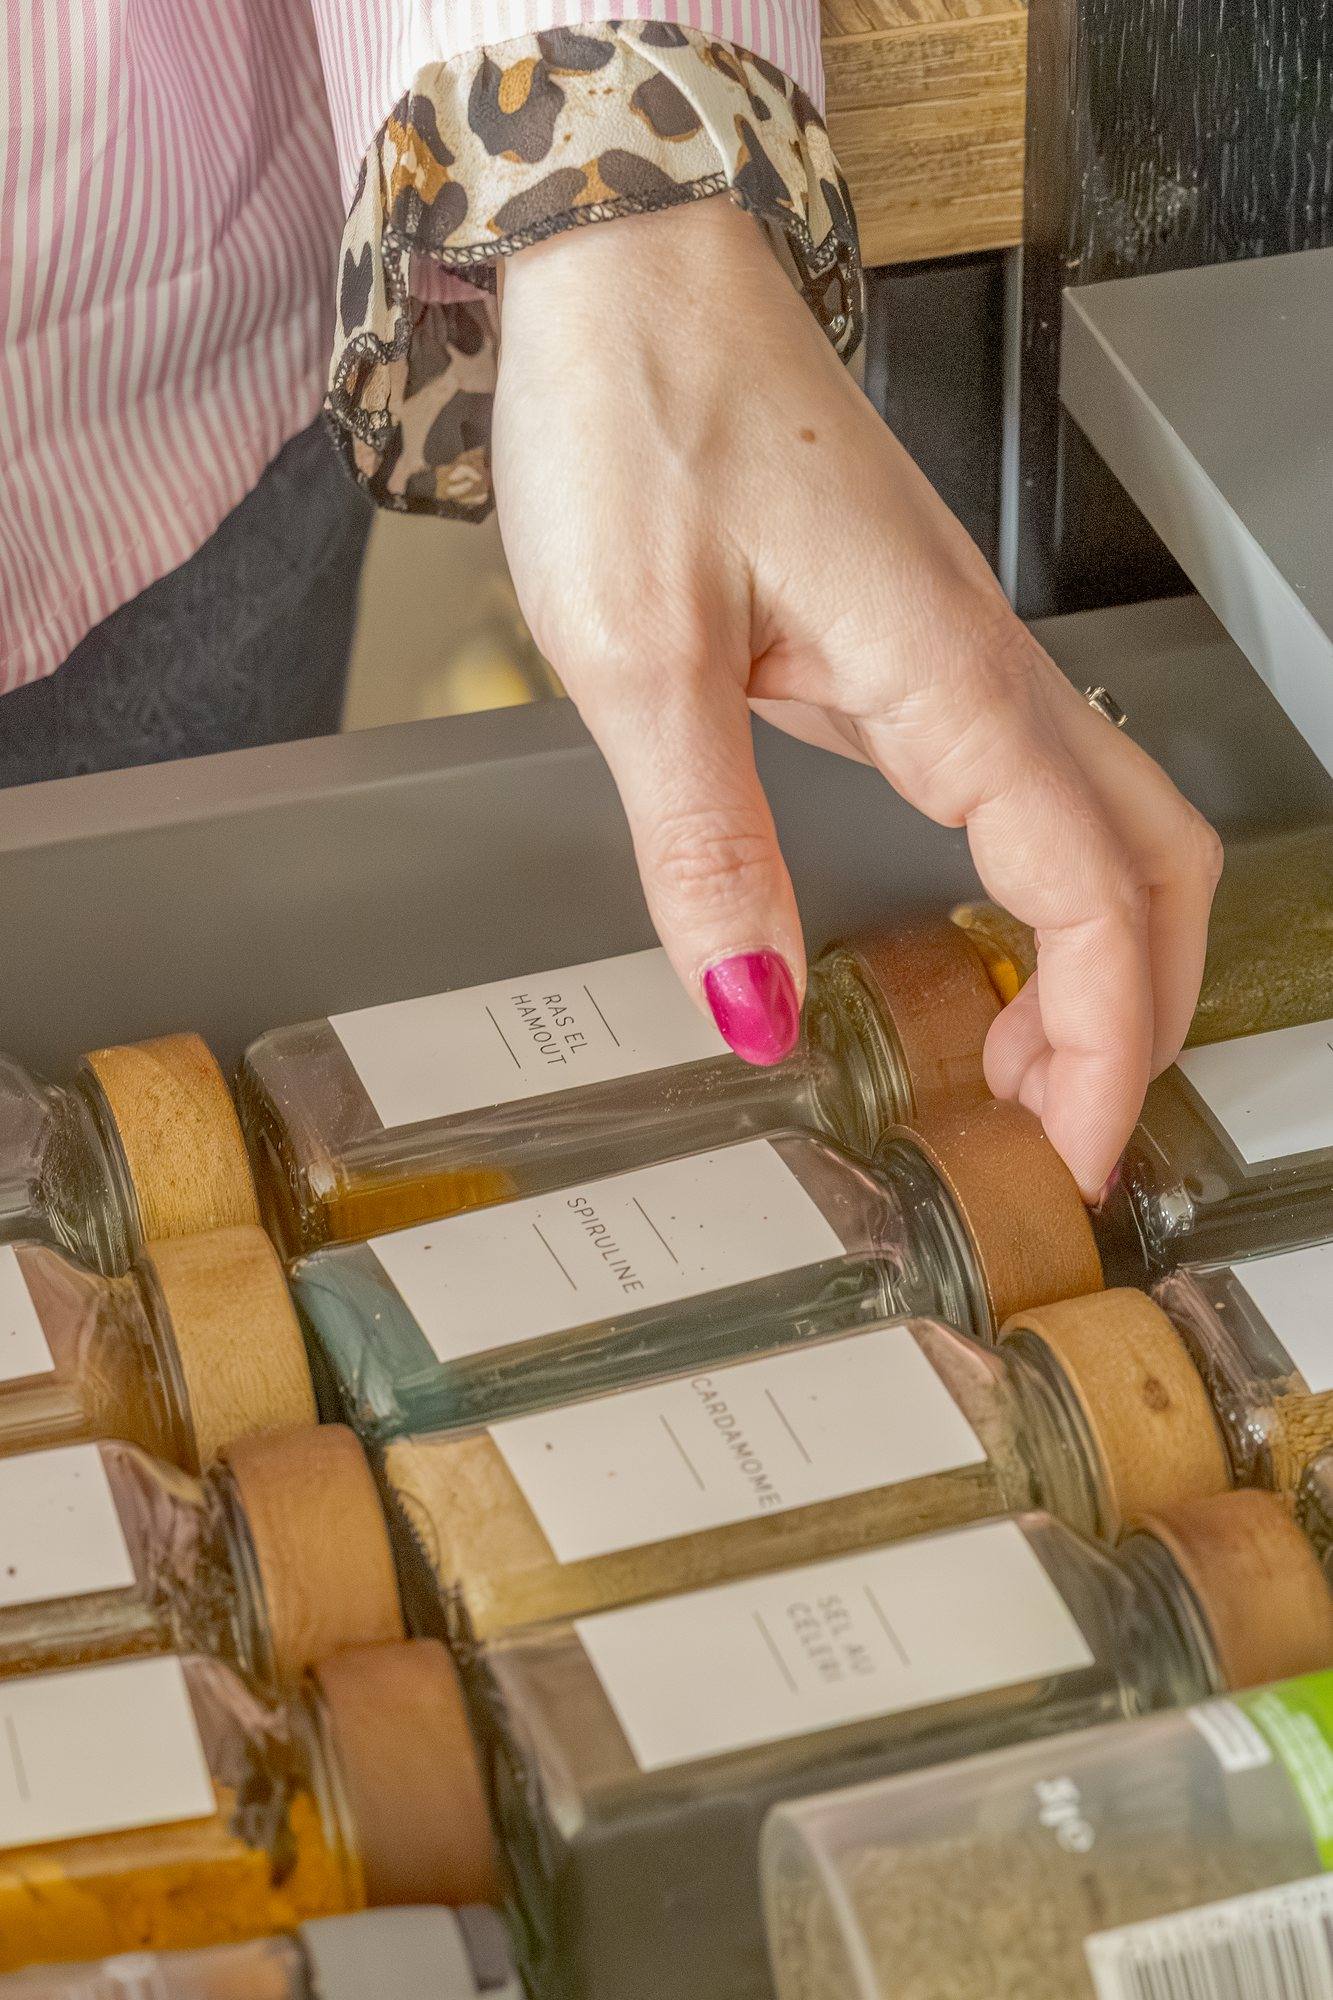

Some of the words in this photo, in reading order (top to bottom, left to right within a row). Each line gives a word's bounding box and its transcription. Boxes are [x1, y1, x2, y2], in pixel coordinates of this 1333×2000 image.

[511, 993, 567, 1065] HAMOUT
[542, 993, 574, 1028] RAS
[564, 1030, 588, 1054] EL
[566, 1196, 645, 1294] SPIRULINE
[690, 1376, 782, 1509] CARDAMOME
